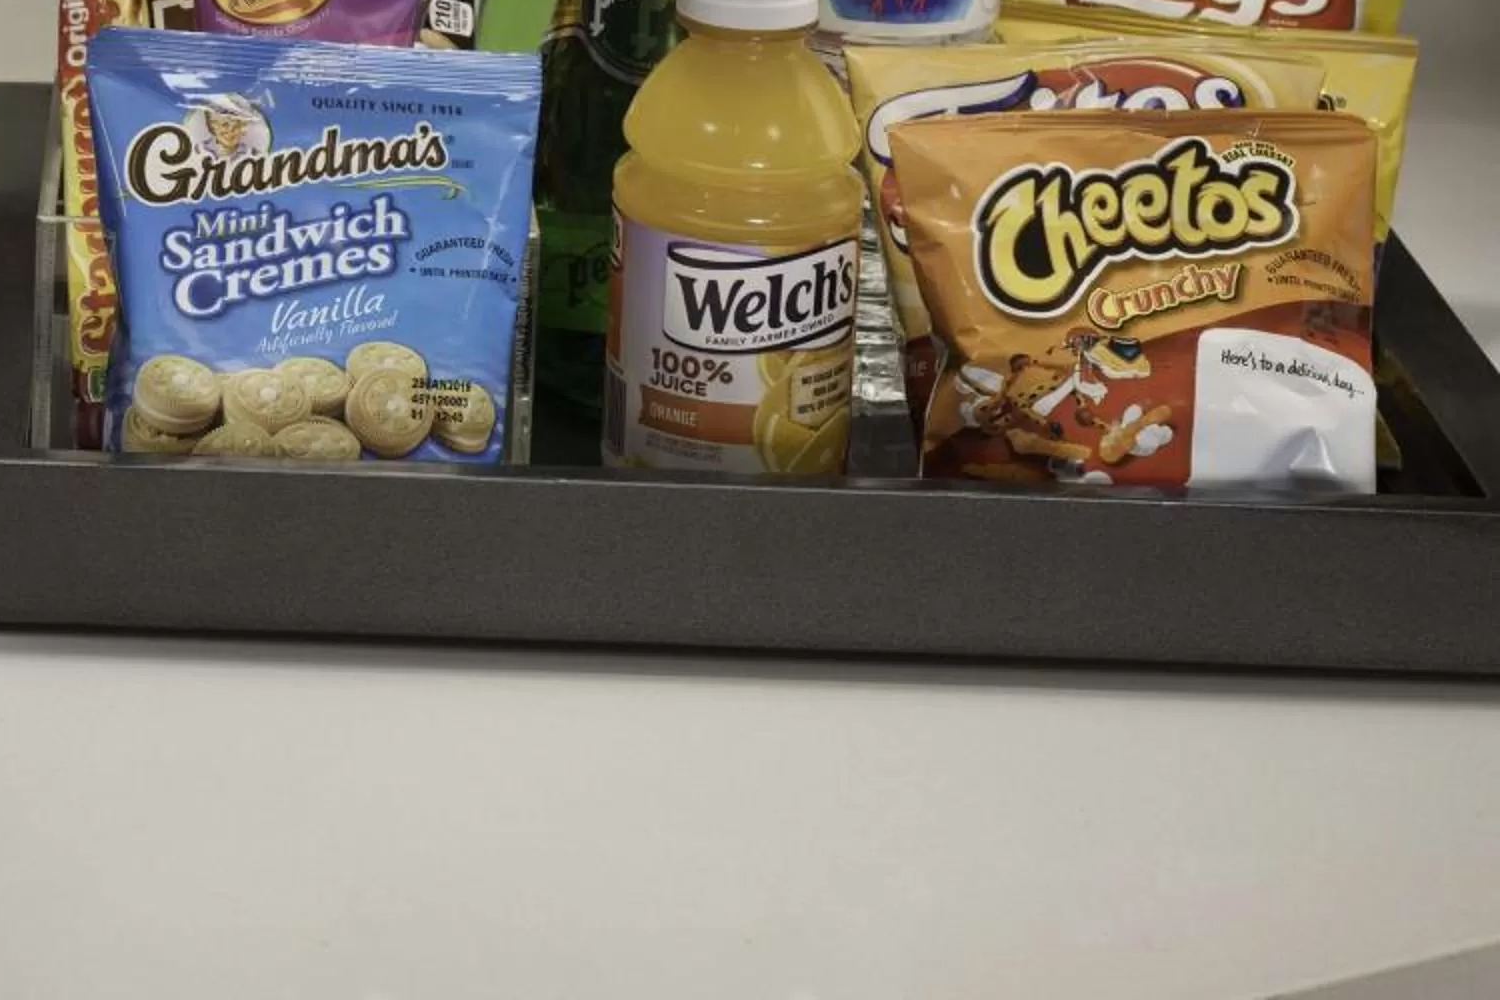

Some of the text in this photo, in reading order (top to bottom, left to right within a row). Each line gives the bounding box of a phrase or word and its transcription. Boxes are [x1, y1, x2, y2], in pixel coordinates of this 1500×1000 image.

[435, 0, 453, 29] 210
[312, 97, 375, 112] QUALITY
[382, 100, 423, 115] SINCE
[131, 123, 447, 203] Grandma's
[163, 196, 406, 270] Sandwich
[197, 208, 270, 239] Mini
[984, 143, 1285, 306] Cheetos
[415, 236, 485, 261] GUARANTEED
[175, 244, 392, 316] Cremes
[675, 253, 854, 334] Welch's
[1089, 263, 1242, 327] Crunchy
[270, 283, 386, 334] Vanilla
[340, 309, 399, 338] Flavored
[705, 313, 835, 346] FAMILY FARMER OWNED
[650, 347, 734, 385] 100%
[1221, 349, 1257, 371] Here's
[1260, 352, 1273, 371] to
[1275, 364, 1286, 374] a
[650, 371, 708, 397] JUICE
[650, 402, 699, 427] ORANGE
